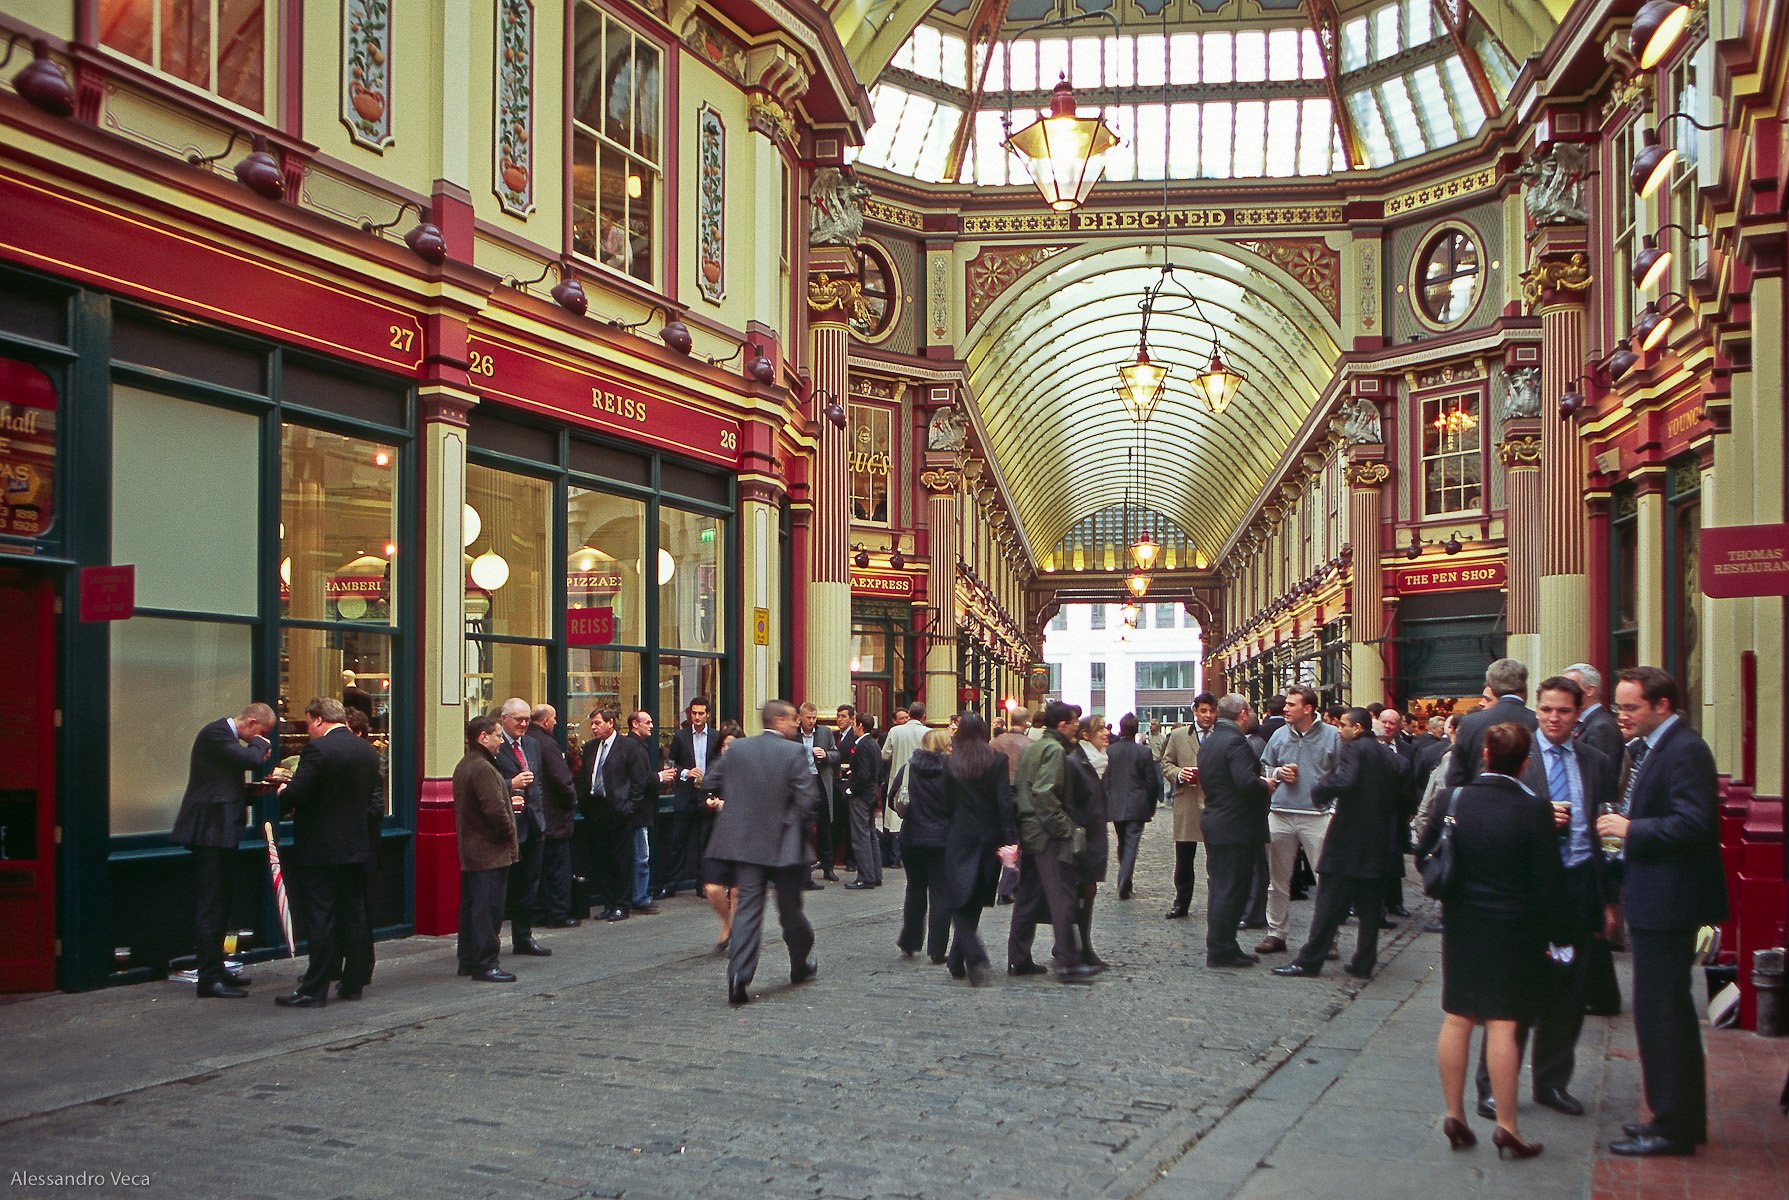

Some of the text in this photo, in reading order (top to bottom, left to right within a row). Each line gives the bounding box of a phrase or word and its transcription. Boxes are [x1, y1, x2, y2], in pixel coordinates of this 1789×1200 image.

[1077, 209, 1226, 230] ERECTED
[389, 325, 415, 352] 27
[469, 351, 495, 377] 26
[591, 387, 647, 422] REISS
[720, 429, 737, 450] 26
[1405, 568, 1497, 585] THE PEN SHOP
[571, 618, 609, 635] REISS
